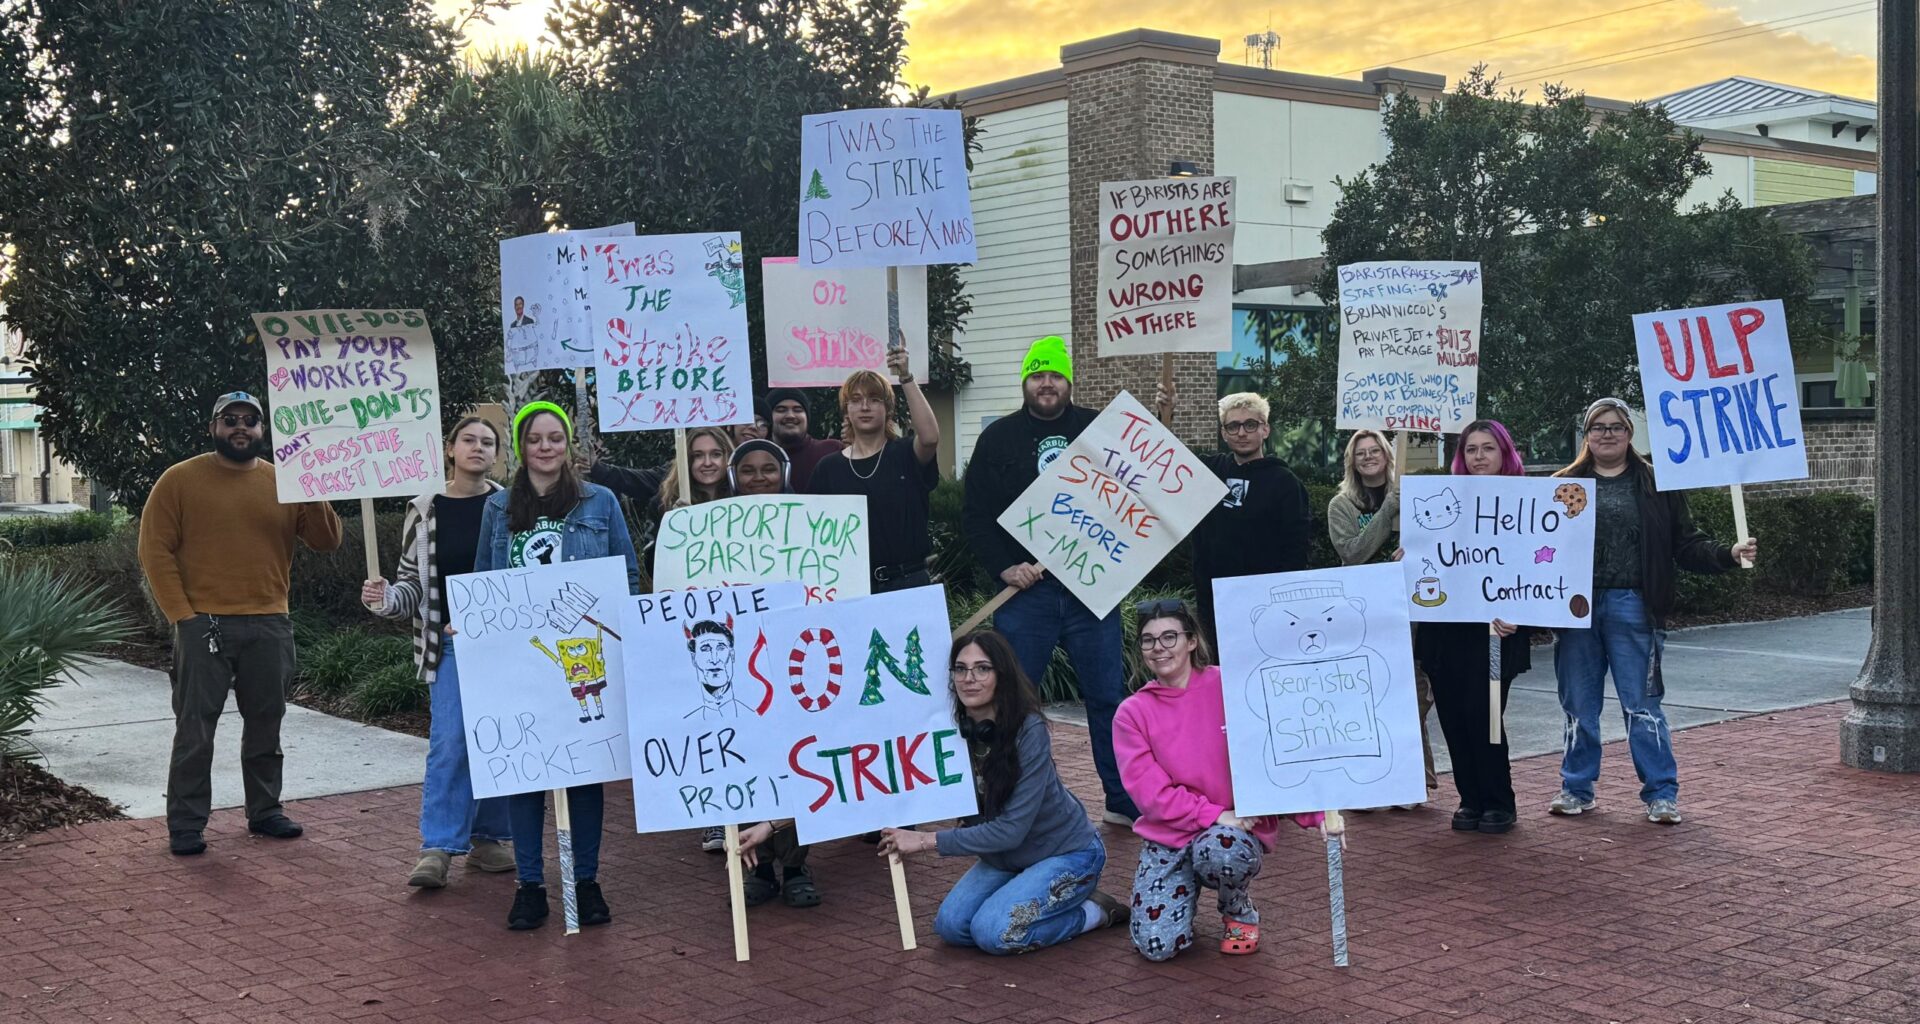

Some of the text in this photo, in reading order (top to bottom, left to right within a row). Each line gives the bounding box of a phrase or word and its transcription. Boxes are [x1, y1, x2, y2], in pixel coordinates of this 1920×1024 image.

[815, 117, 947, 165] TWAS THE
[846, 157, 946, 210] STRIKE
[1109, 180, 1231, 210] IF BARISTAS ARE
[557, 245, 576, 265] Mr.
[807, 210, 919, 265] BEFORE
[595, 243, 675, 284] Twas
[1115, 243, 1225, 280] SOMETHINGS
[622, 285, 672, 312] THE
[1108, 273, 1204, 308] WRONG
[1343, 284, 1417, 302] STAFFING:
[603, 317, 731, 368] Strike
[1104, 311, 1197, 342] IN THERE
[1353, 328, 1402, 345] PRIVATE
[1404, 328, 1424, 344] JET
[1436, 325, 1472, 353] $113
[1652, 307, 1766, 382] ULP
[276, 335, 412, 360] PAY YOUR
[1359, 344, 1478, 367] PAY PACKAGE MILLION
[290, 359, 408, 392] WORKERS
[617, 365, 729, 392] BEFORE
[1344, 371, 1459, 394] SOMEONE WHO IS
[1343, 385, 1475, 407] GOOD AT BUSINESS HELP
[1343, 404, 1462, 421] ME MY COMPANY IS
[1385, 414, 1441, 431] DYING
[1659, 373, 1796, 464] STRIKE
[275, 432, 313, 462] DON'T
[301, 428, 404, 471] CROSS THE
[1120, 411, 1193, 494] TWAS
[299, 459, 365, 498] PICKET
[1103, 448, 1148, 494] THE
[1058, 455, 1161, 539] STRIKE
[1475, 496, 1560, 535] Hello
[663, 502, 861, 557] SUPPORT YOUR
[1016, 506, 1106, 586] X-MAS
[1051, 493, 1130, 563] BEFORE
[686, 540, 840, 586] BARISTAS
[1437, 541, 1504, 567] Union
[450, 571, 535, 613] DON'T
[638, 588, 769, 625] PEOPLE
[1482, 574, 1568, 602] Contract
[463, 604, 548, 640] CROSS
[472, 712, 541, 754] OUR
[1275, 701, 1374, 753] Strike!
[644, 727, 747, 778] OVER
[788, 729, 963, 814] STRIKE
